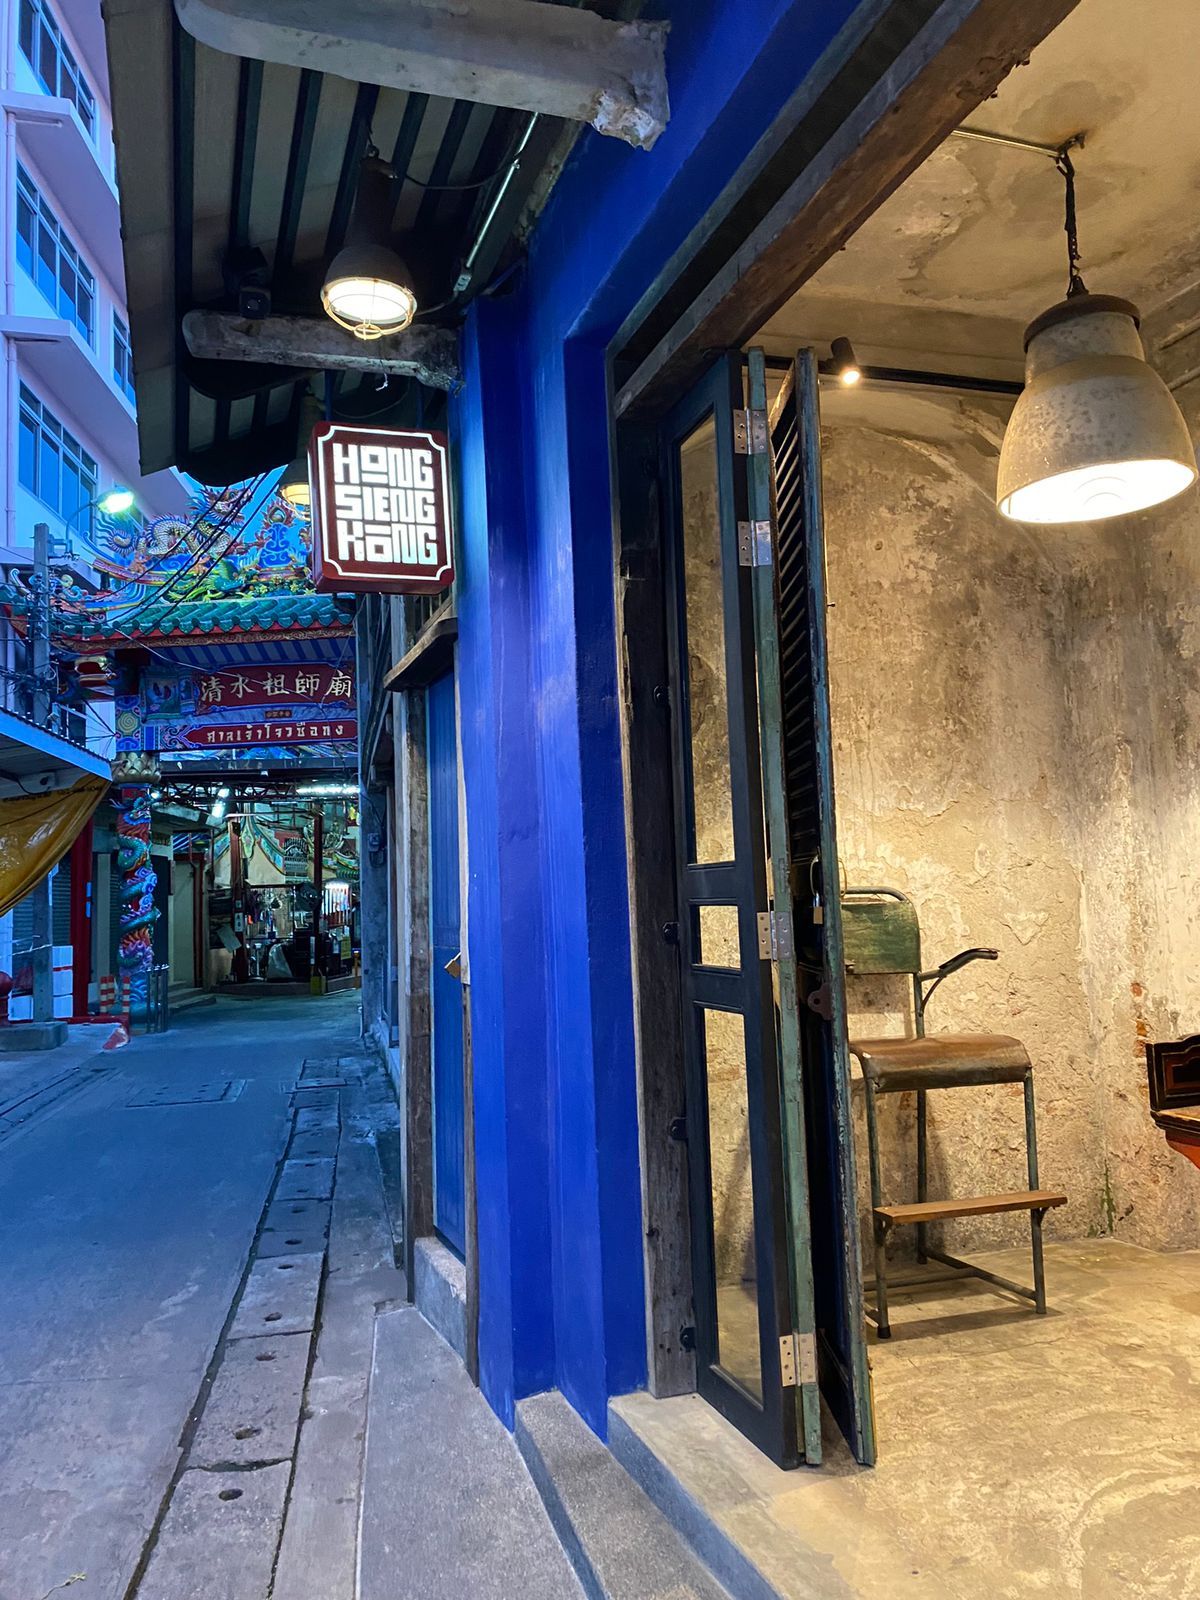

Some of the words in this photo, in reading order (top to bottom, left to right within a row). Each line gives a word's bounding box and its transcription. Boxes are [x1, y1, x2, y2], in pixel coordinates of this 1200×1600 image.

[333, 443, 434, 489] HONG
[335, 484, 436, 524] SIENG
[337, 520, 438, 565] KONG
[201, 670, 351, 702] 清水祖師廟
